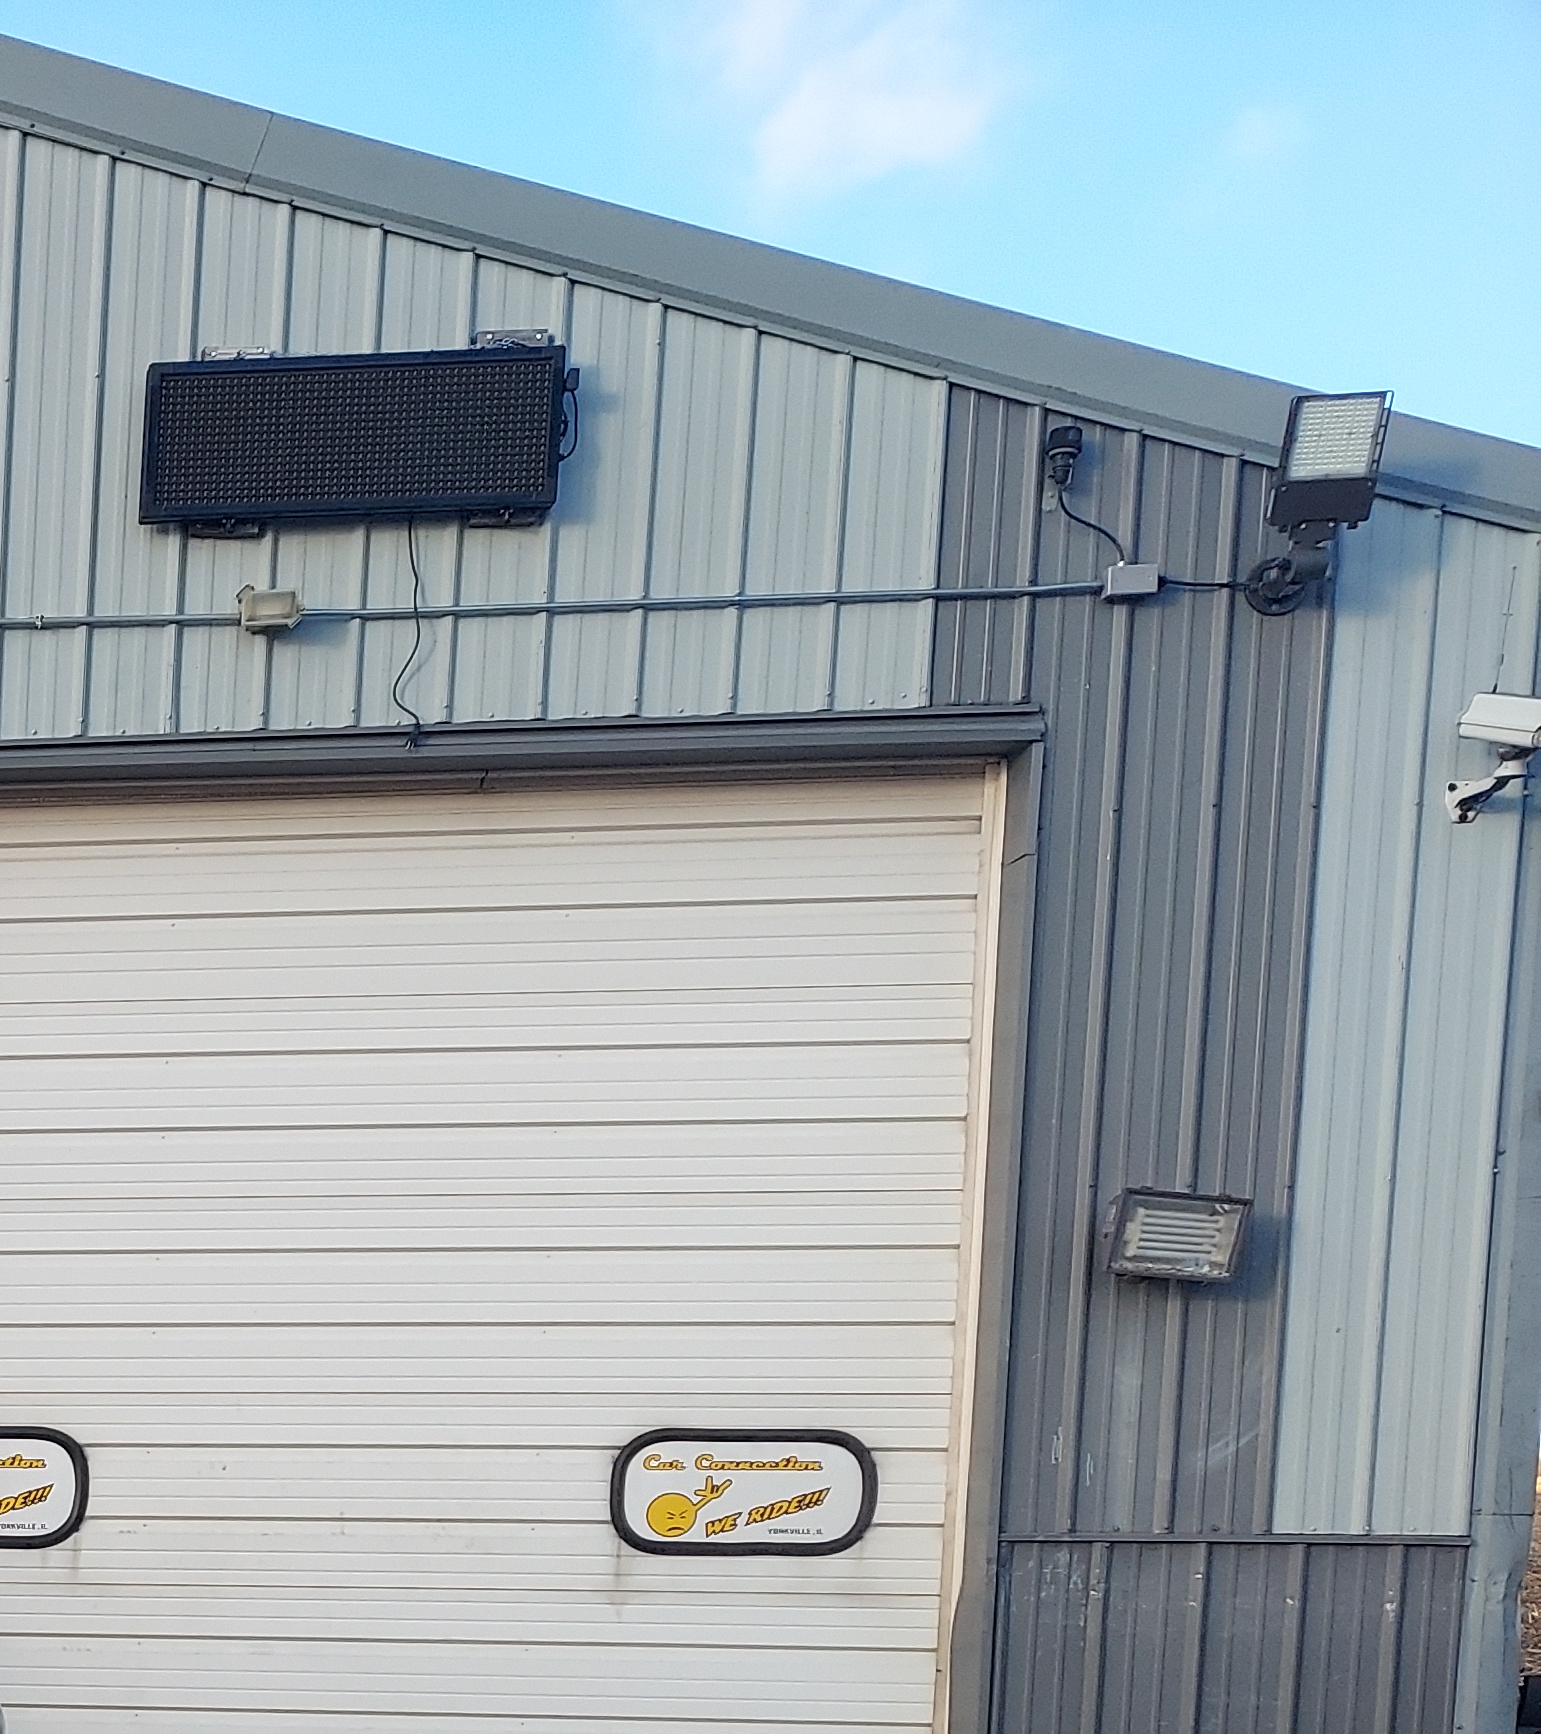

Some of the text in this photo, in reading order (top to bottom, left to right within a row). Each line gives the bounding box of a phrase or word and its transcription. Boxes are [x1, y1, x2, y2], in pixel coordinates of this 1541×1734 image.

[643, 1453, 824, 1472] Car Connection
[705, 1486, 832, 1538] WE RIDE!!!
